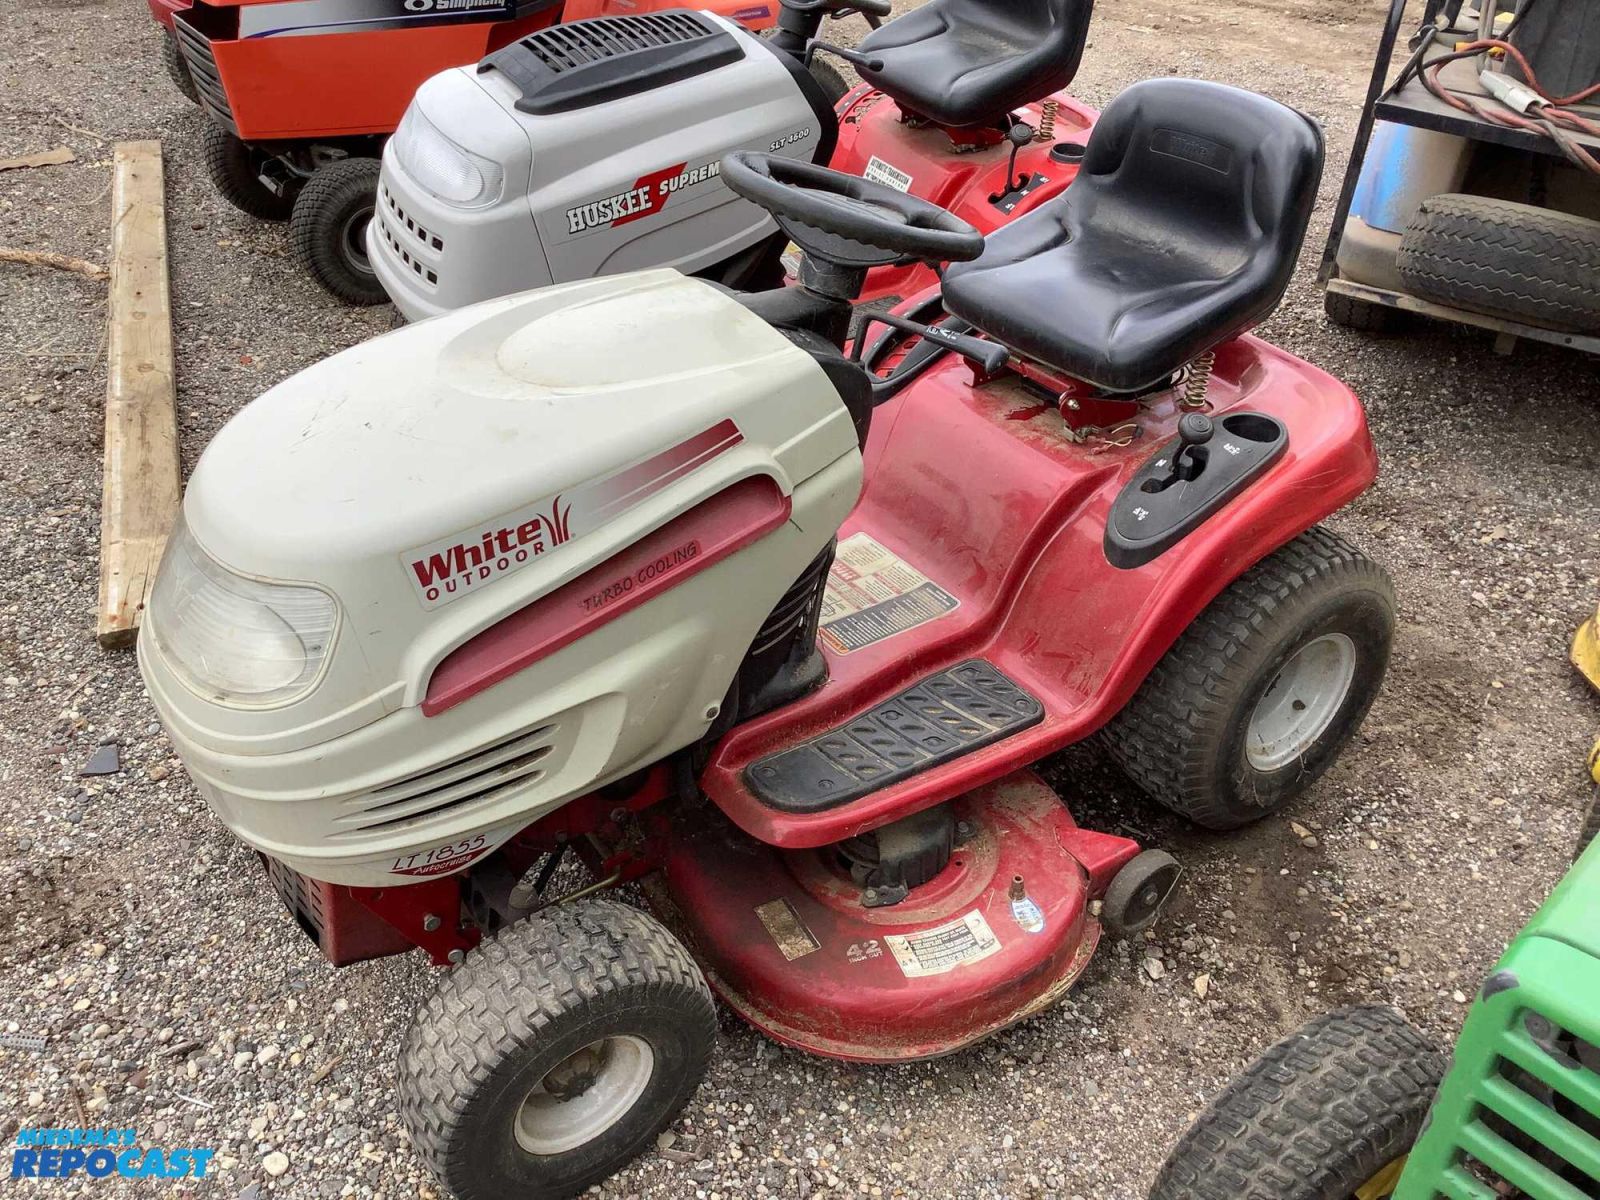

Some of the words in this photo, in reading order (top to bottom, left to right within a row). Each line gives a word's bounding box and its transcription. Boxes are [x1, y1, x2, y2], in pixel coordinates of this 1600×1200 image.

[769, 137, 787, 153] SLT
[566, 185, 653, 234] HUSKEE
[659, 160, 721, 196] SUPREM
[412, 518, 542, 588] White
[426, 541, 545, 601] OUTDOOR
[583, 577, 633, 611] TURBO
[637, 542, 697, 584] COOLING
[413, 854, 473, 876] Autocruise
[426, 834, 486, 864] 1855
[846, 940, 882, 957] 42
